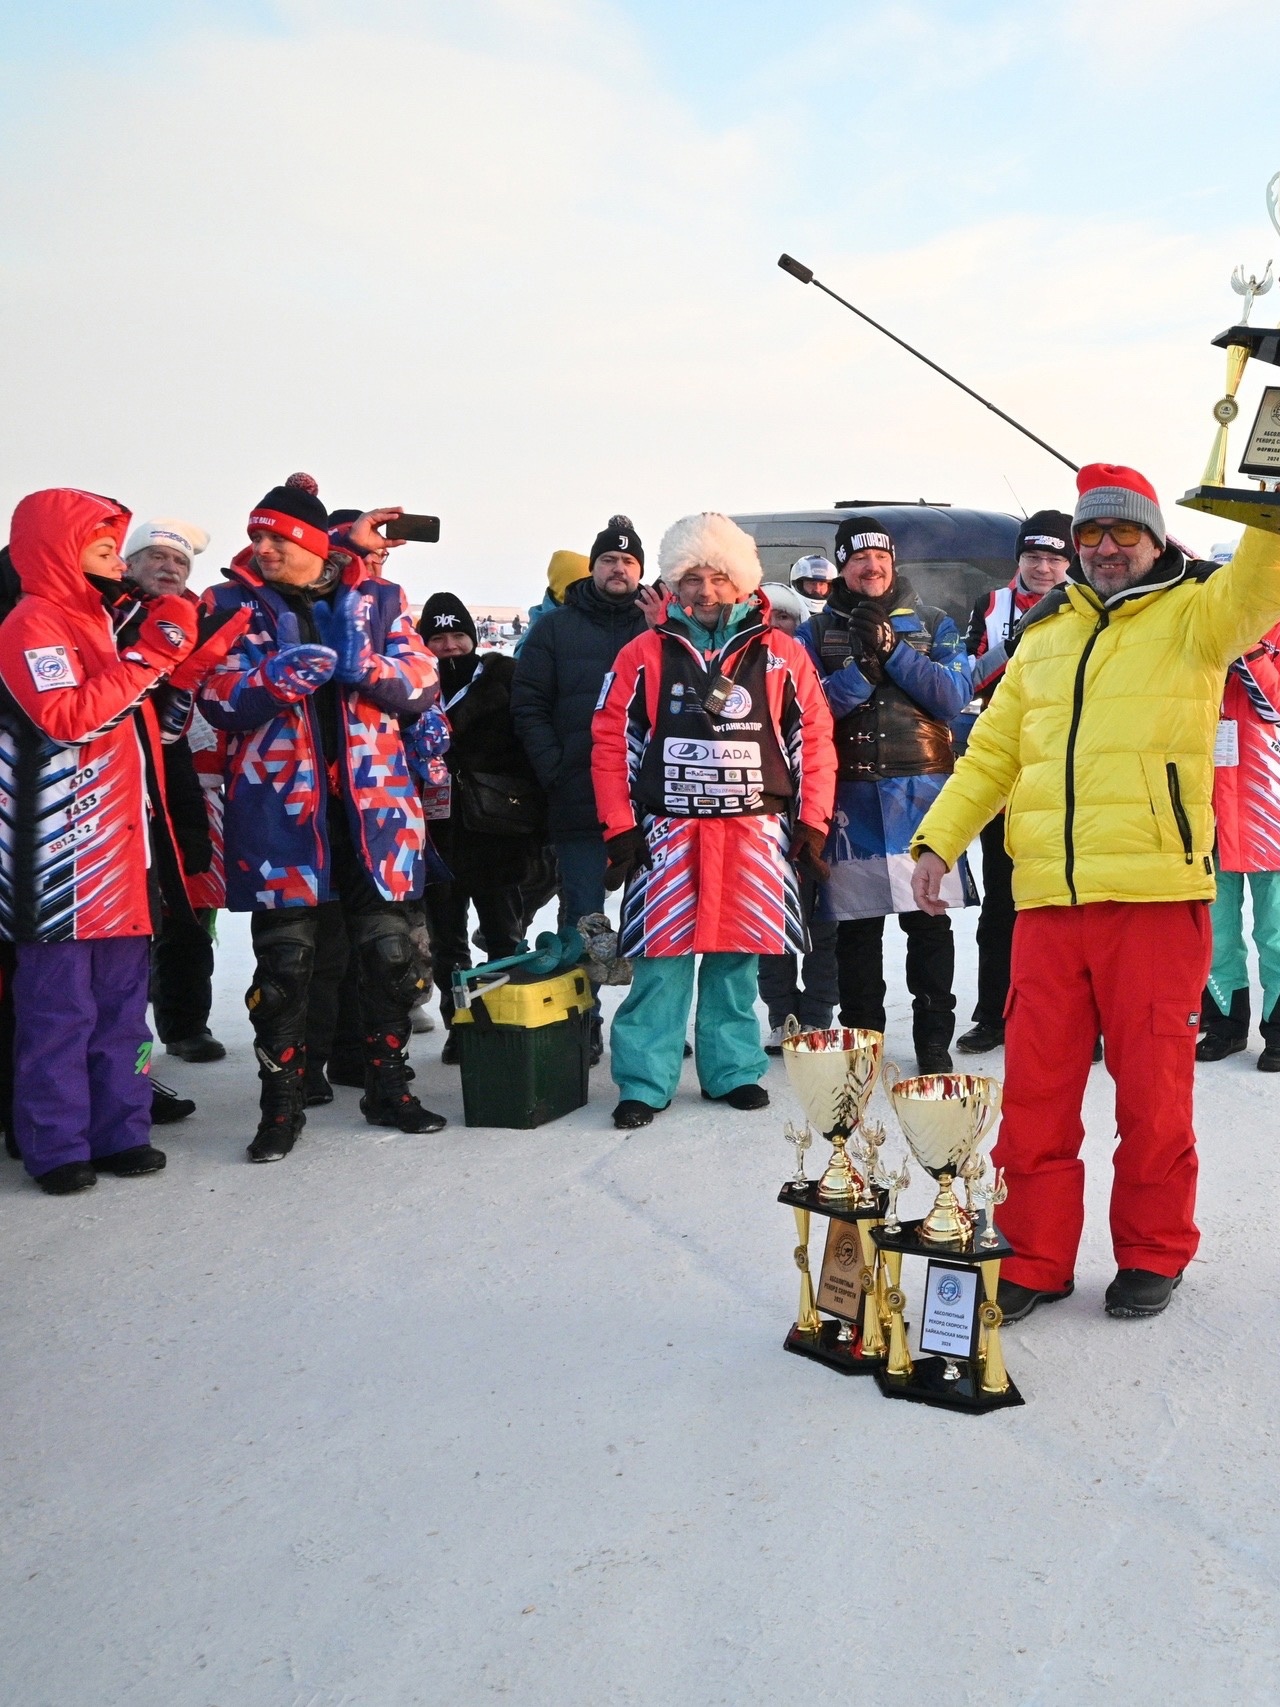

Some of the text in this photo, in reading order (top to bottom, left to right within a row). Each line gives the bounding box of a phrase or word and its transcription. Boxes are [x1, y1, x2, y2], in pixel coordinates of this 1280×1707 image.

[850, 532, 890, 551] MOTORCITY
[433, 613, 461, 628] DIOR
[712, 748, 752, 760] LADA
[69, 767, 94, 790] 470
[64, 793, 97, 821] 1433
[933, 1309, 965, 1320] АБСОЛЮТНЫЙ
[928, 1318, 969, 1331] РЕКОРД СКОРОСТИ
[925, 1327, 956, 1338] БАЙКАЛЬСКАЯ
